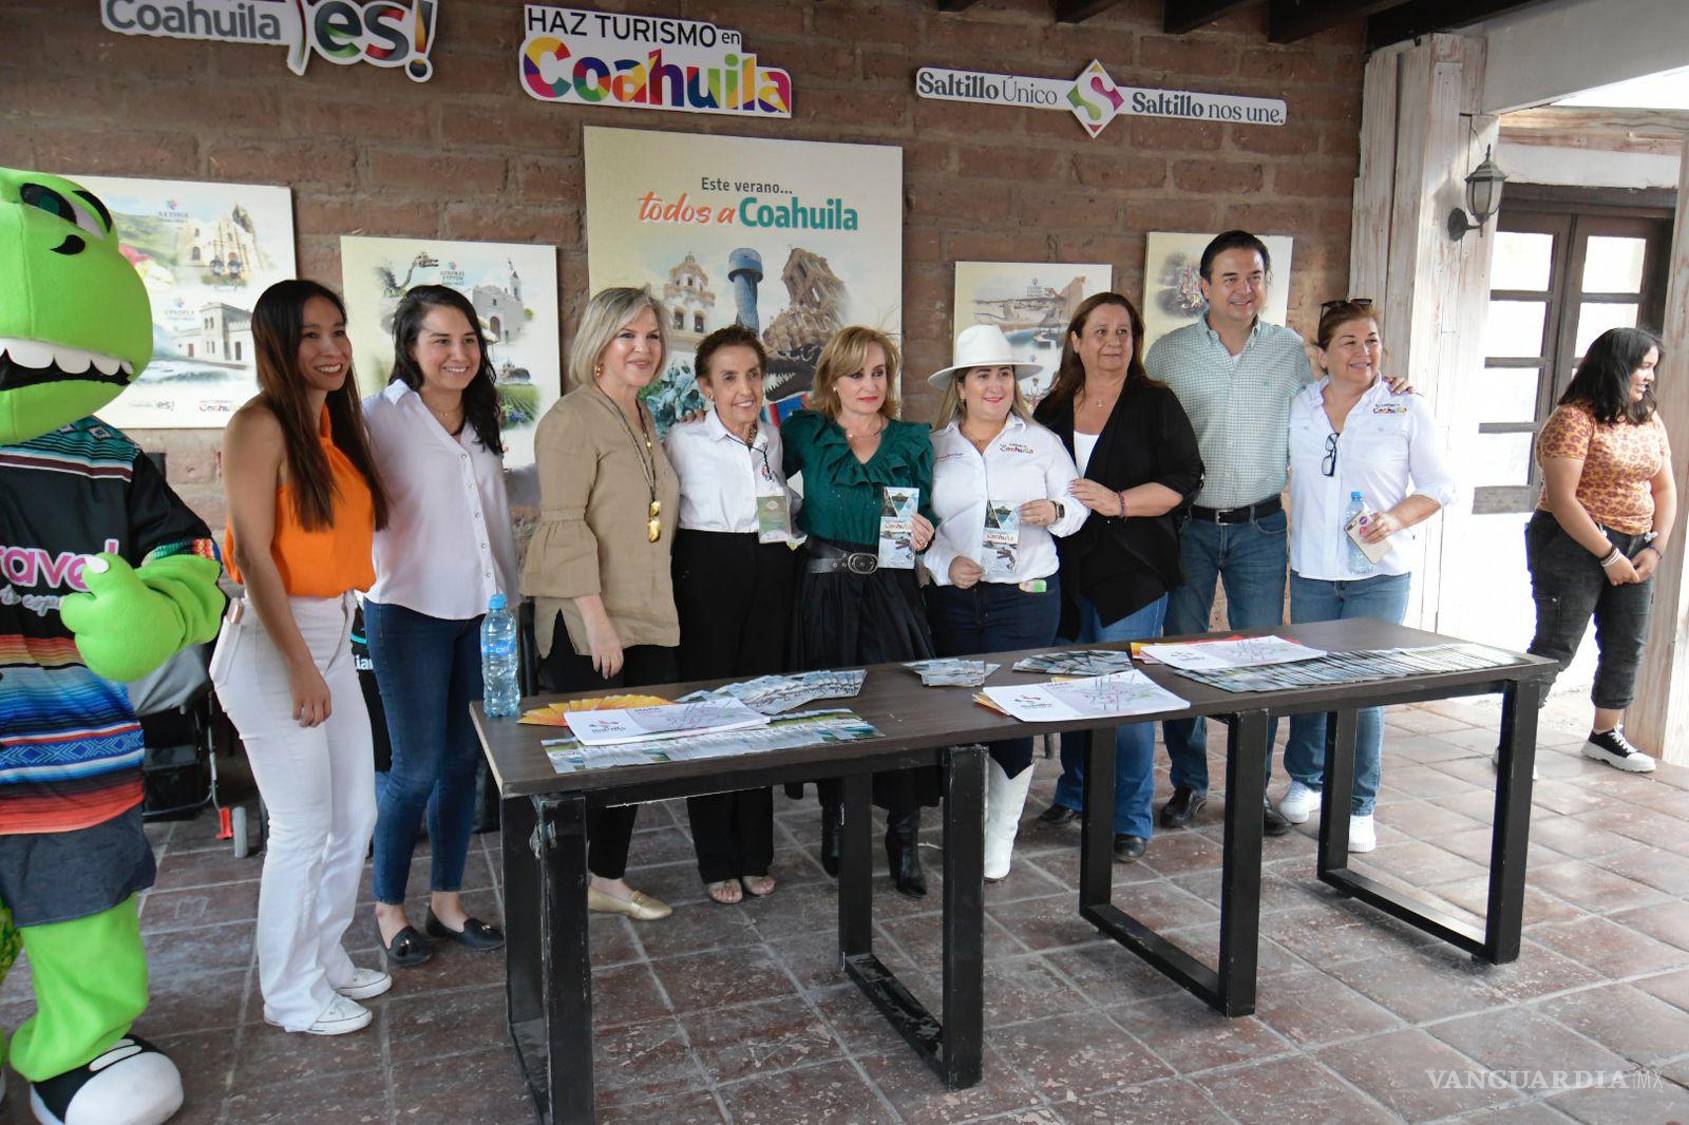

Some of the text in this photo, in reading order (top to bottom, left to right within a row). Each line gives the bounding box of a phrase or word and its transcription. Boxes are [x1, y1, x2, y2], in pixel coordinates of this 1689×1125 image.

[105, 0, 281, 41] Coahuila
[527, 8, 741, 48] HAZ TURISMO en
[523, 36, 791, 113] Coahuila
[918, 71, 1058, 105] Saltillo Único
[1131, 91, 1285, 124] Saltillo nos une.
[701, 176, 793, 195] Este verano...
[637, 191, 859, 231] todos a Coahuila
